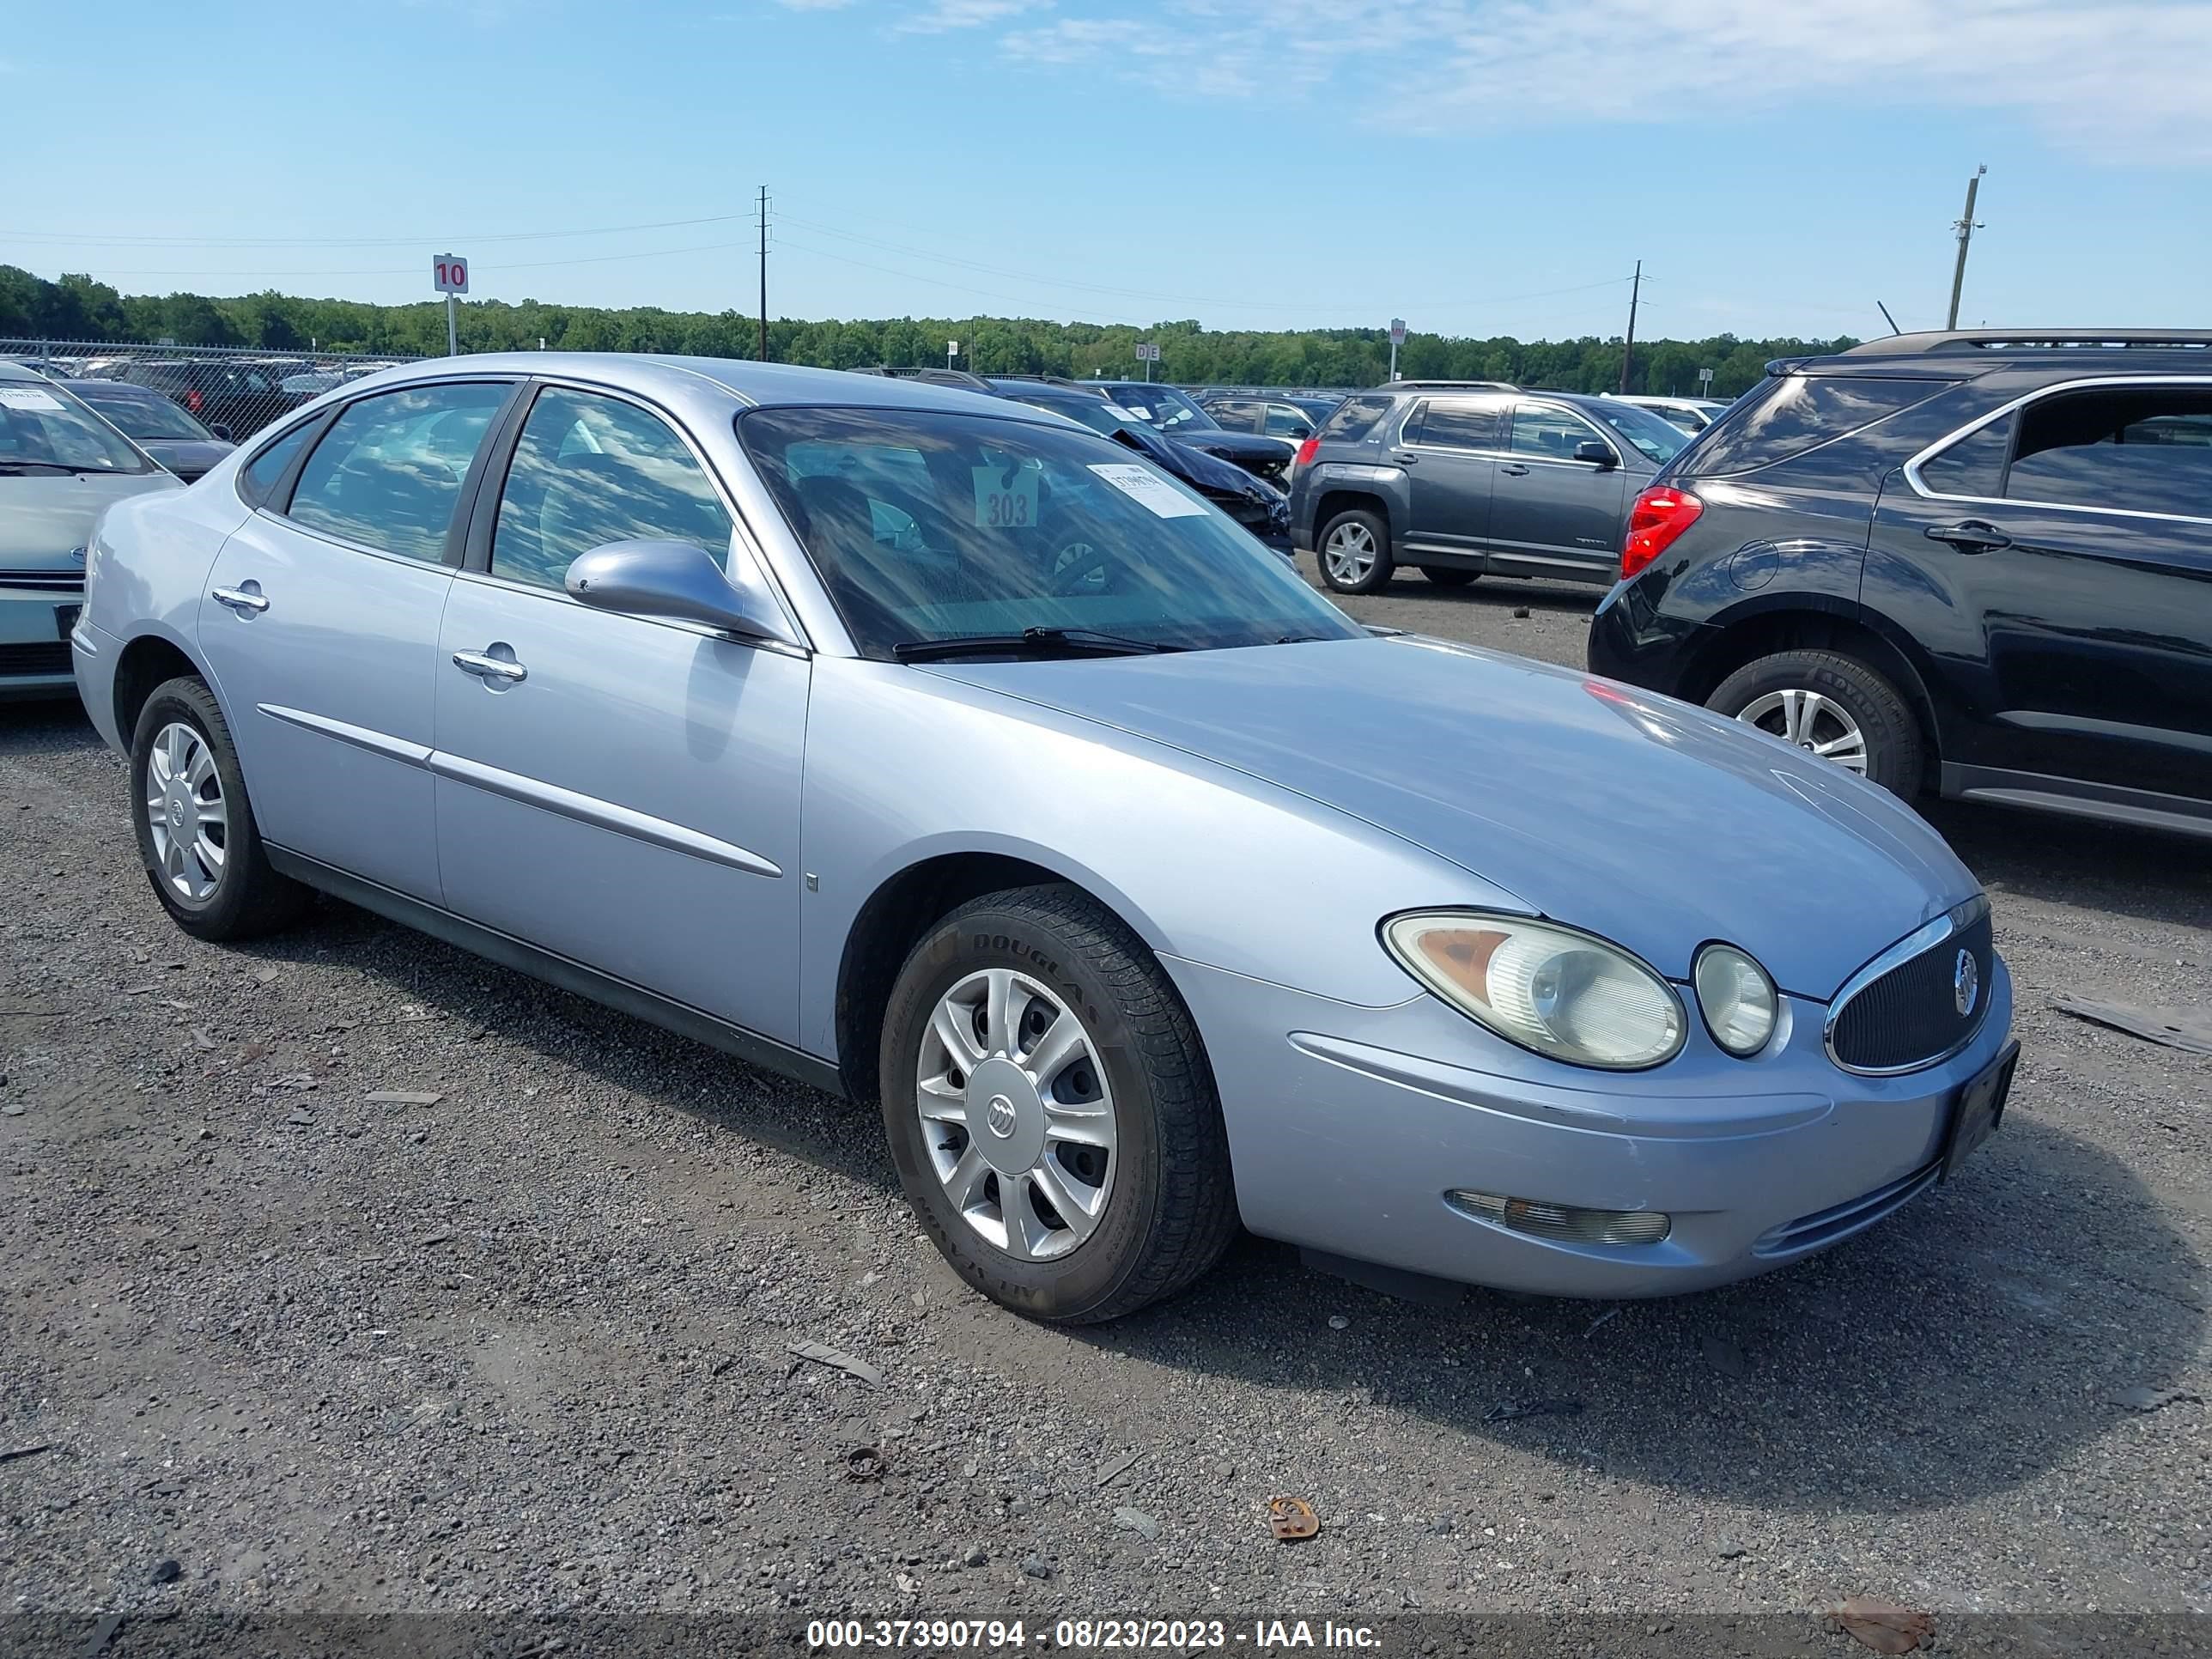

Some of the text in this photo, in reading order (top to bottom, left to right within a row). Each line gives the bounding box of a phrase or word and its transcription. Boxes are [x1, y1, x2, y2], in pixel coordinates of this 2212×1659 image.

[436, 263, 465, 286] 10
[1139, 347, 1158, 358] D E
[988, 493, 1027, 526] 303
[973, 933, 1101, 1025] DOUGLAS
